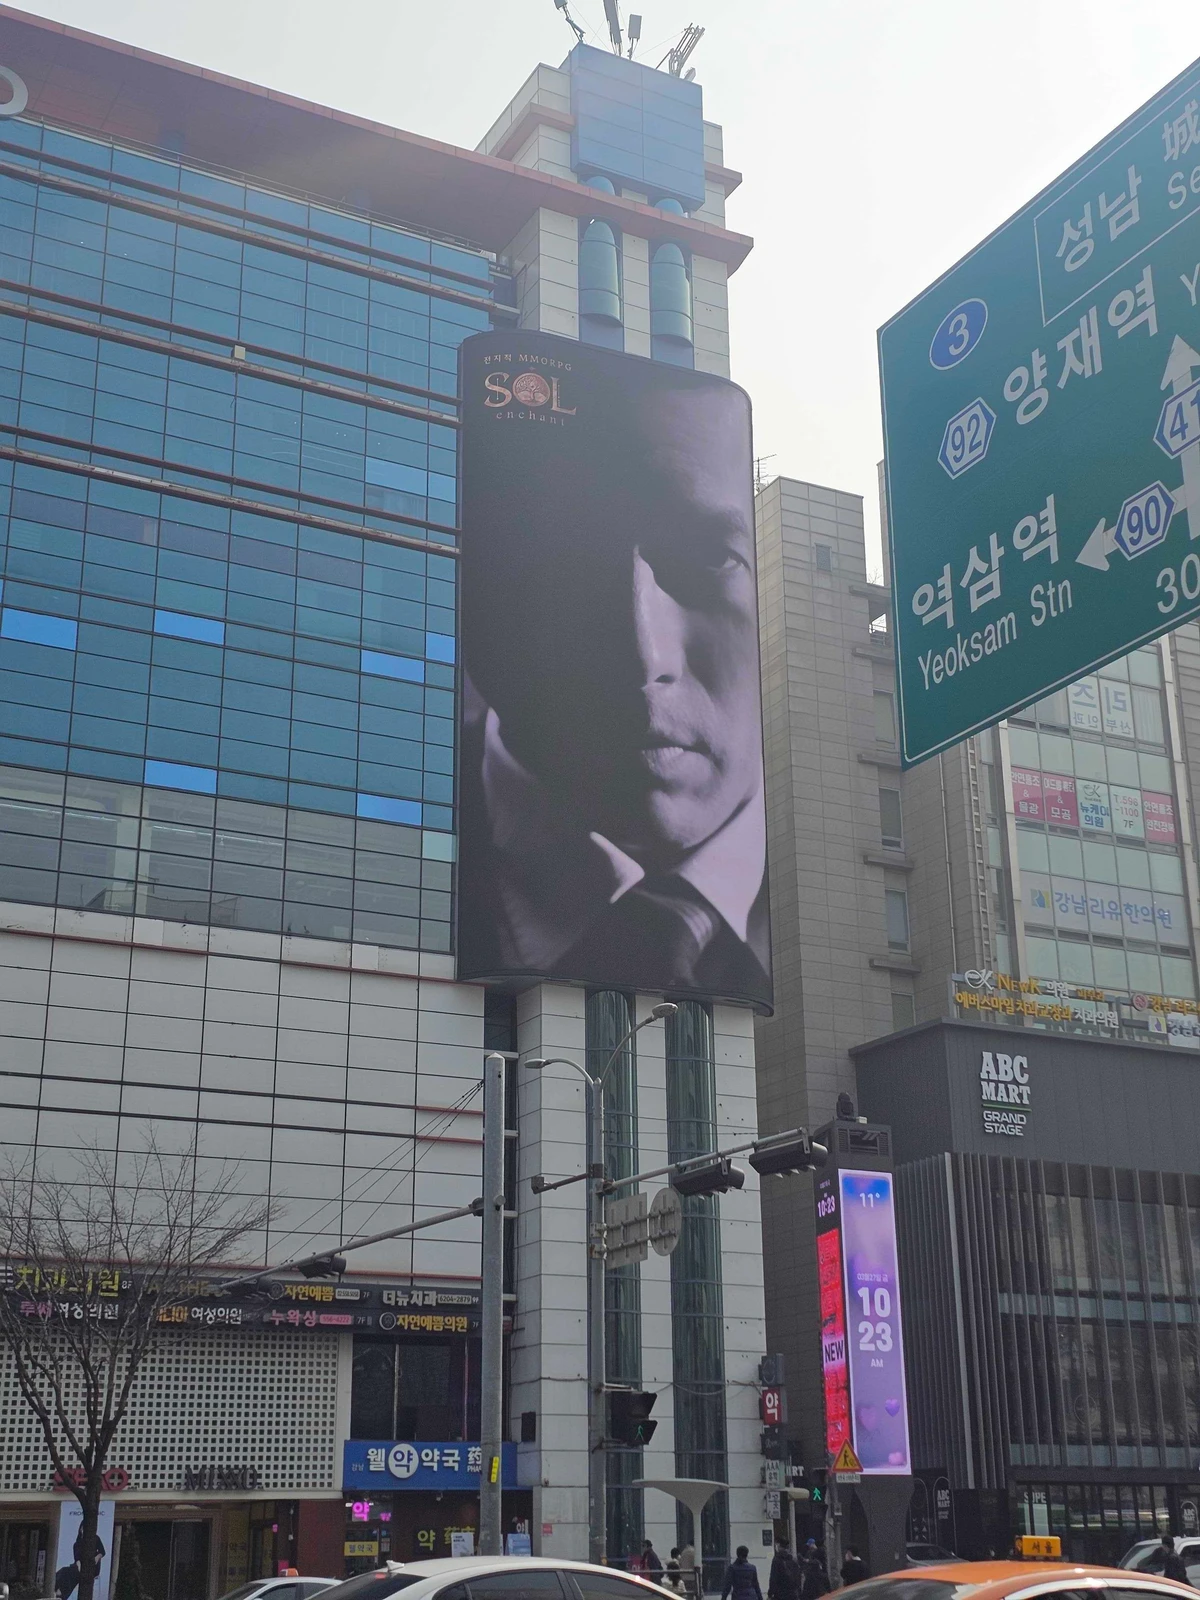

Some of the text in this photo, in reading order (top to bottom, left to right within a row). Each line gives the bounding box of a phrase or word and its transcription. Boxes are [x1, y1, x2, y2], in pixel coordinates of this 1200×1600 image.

[1055, 164, 1142, 272] 성남
[948, 313, 970, 356] 3
[1003, 264, 1158, 425] 양재역
[519, 354, 572, 371] MMORPG
[484, 372, 577, 415] SOL
[950, 413, 982, 464] 92
[1127, 495, 1161, 547] 90
[912, 494, 1059, 629] 역삼역
[918, 579, 1073, 690] Yeoksam Stn
[1085, 814, 1104, 828] 의원
[1123, 819, 1133, 828] 7F
[1046, 981, 1070, 1000] 의원
[980, 1051, 1029, 1085] ABC
[980, 1080, 1031, 1105] MART
[983, 1110, 1027, 1125] GRAND
[984, 1122, 1024, 1136] STAGE
[817, 1194, 836, 1218] 10:23
[382, 1289, 438, 1306] 더뉴치과
[857, 1286, 892, 1318] 10
[191, 1306, 242, 1325] 여성의원
[858, 1320, 893, 1352] 23
[825, 1339, 844, 1363] NEW
[870, 1358, 884, 1368] AM
[765, 1391, 780, 1422] 약
[417, 1529, 436, 1552] 약
